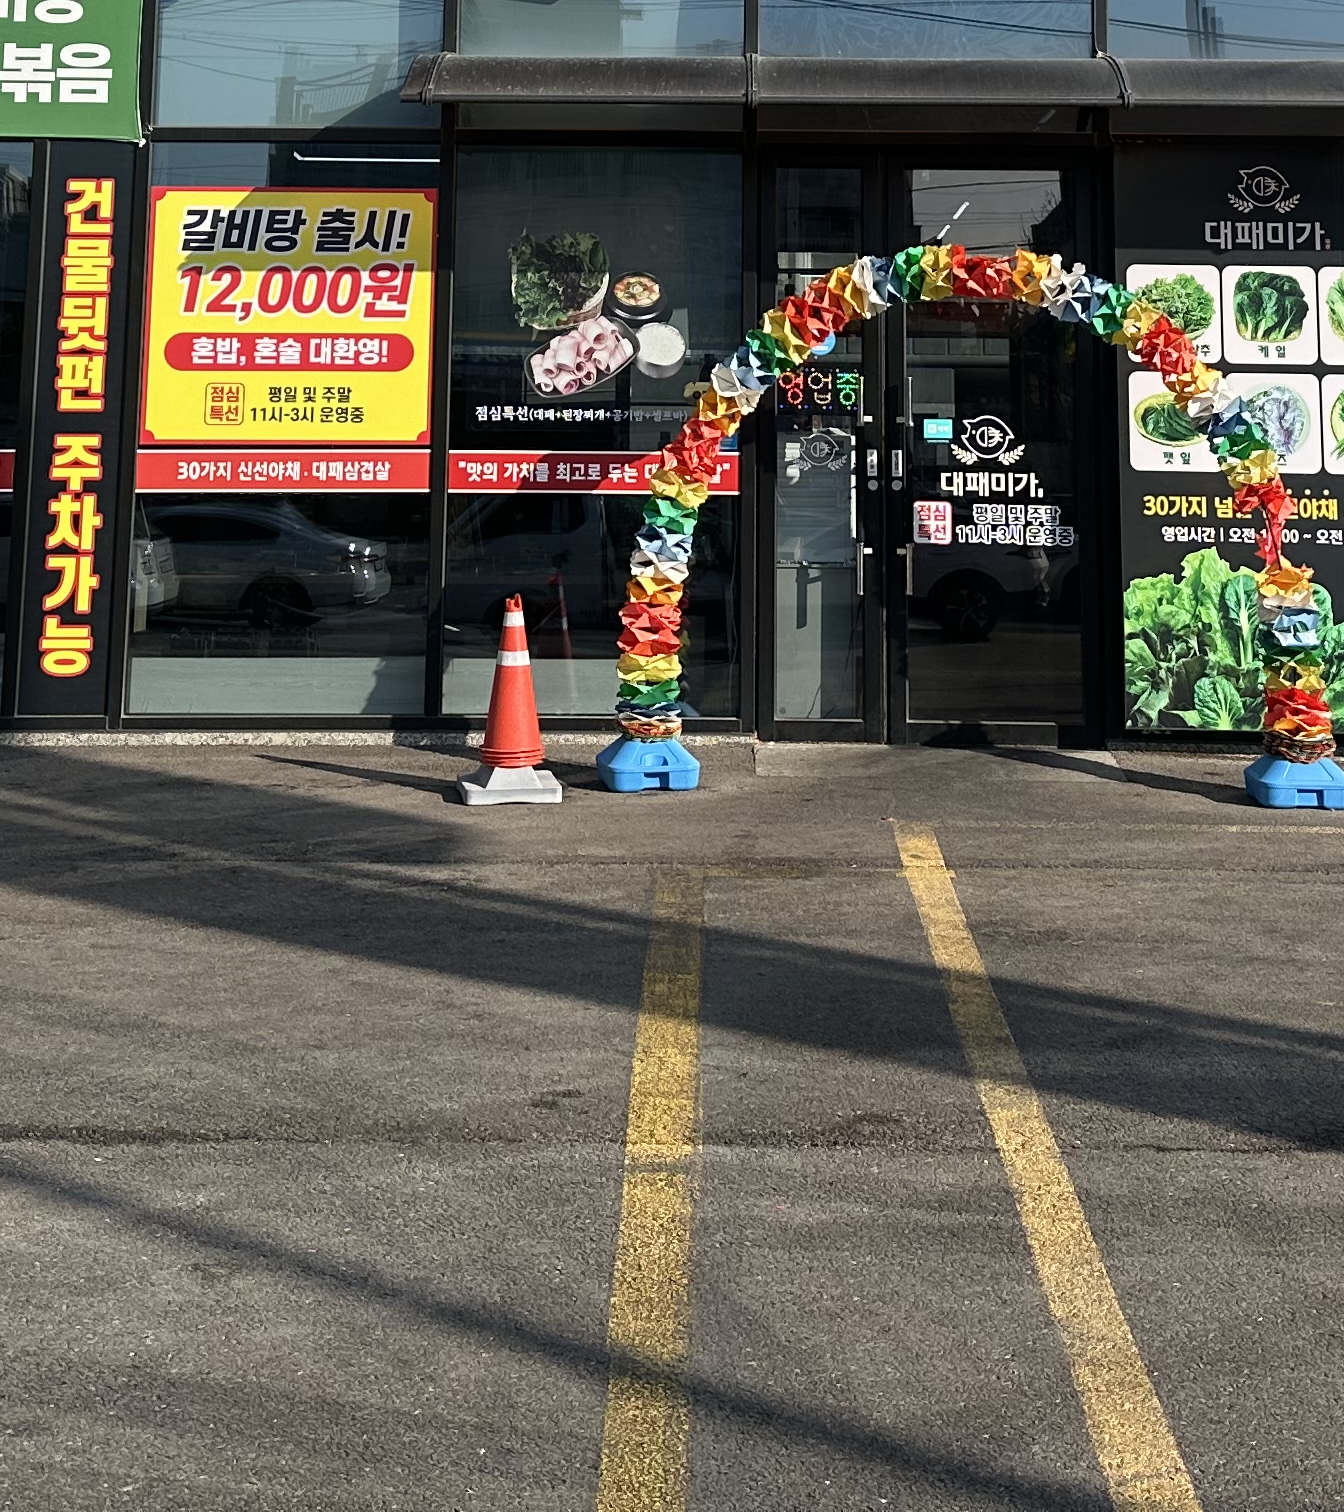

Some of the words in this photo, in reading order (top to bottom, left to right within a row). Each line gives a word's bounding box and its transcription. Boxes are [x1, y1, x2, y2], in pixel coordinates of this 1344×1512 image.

[181, 208, 306, 252] 갈비탕
[314, 208, 411, 252] 출시!
[1205, 220, 1325, 250] 대패미가
[55, 177, 115, 412] 건물뒷편
[178, 262, 416, 322] 12,000원
[192, 337, 246, 366] 혼밥,
[254, 338, 302, 366] 혼술
[310, 338, 388, 366] 대환영!
[210, 386, 240, 402] 점심
[268, 386, 296, 402] 평일
[303, 386, 316, 402] 및
[322, 386, 352, 402] 주말
[778, 370, 860, 406] 영업중
[209, 405, 239, 422] 특선
[250, 406, 314, 423] 11시-3시
[320, 406, 364, 423] 운영중
[177, 462, 231, 480] 30가지
[238, 462, 300, 480] 신선야채
[312, 462, 391, 482] 대패삼겹살
[504, 462, 550, 482] 가치를
[556, 462, 601, 482] 최고로
[608, 462, 638, 482] 두는
[940, 472, 1038, 497] 대패미가
[917, 504, 946, 522] 점심
[973, 504, 1006, 523] 평일
[1008, 504, 1025, 524] 및
[1027, 504, 1061, 525] 주말
[1142, 496, 1207, 518] 30가지
[956, 525, 1024, 544] 11시-3시
[1026, 526, 1074, 546] 운영중
[1162, 526, 1216, 542] 영업시간
[1228, 528, 1255, 544] 오전
[1259, 528, 1300, 544] 100
[1316, 529, 1344, 546] 오전
[39, 433, 104, 677] 주차가능
